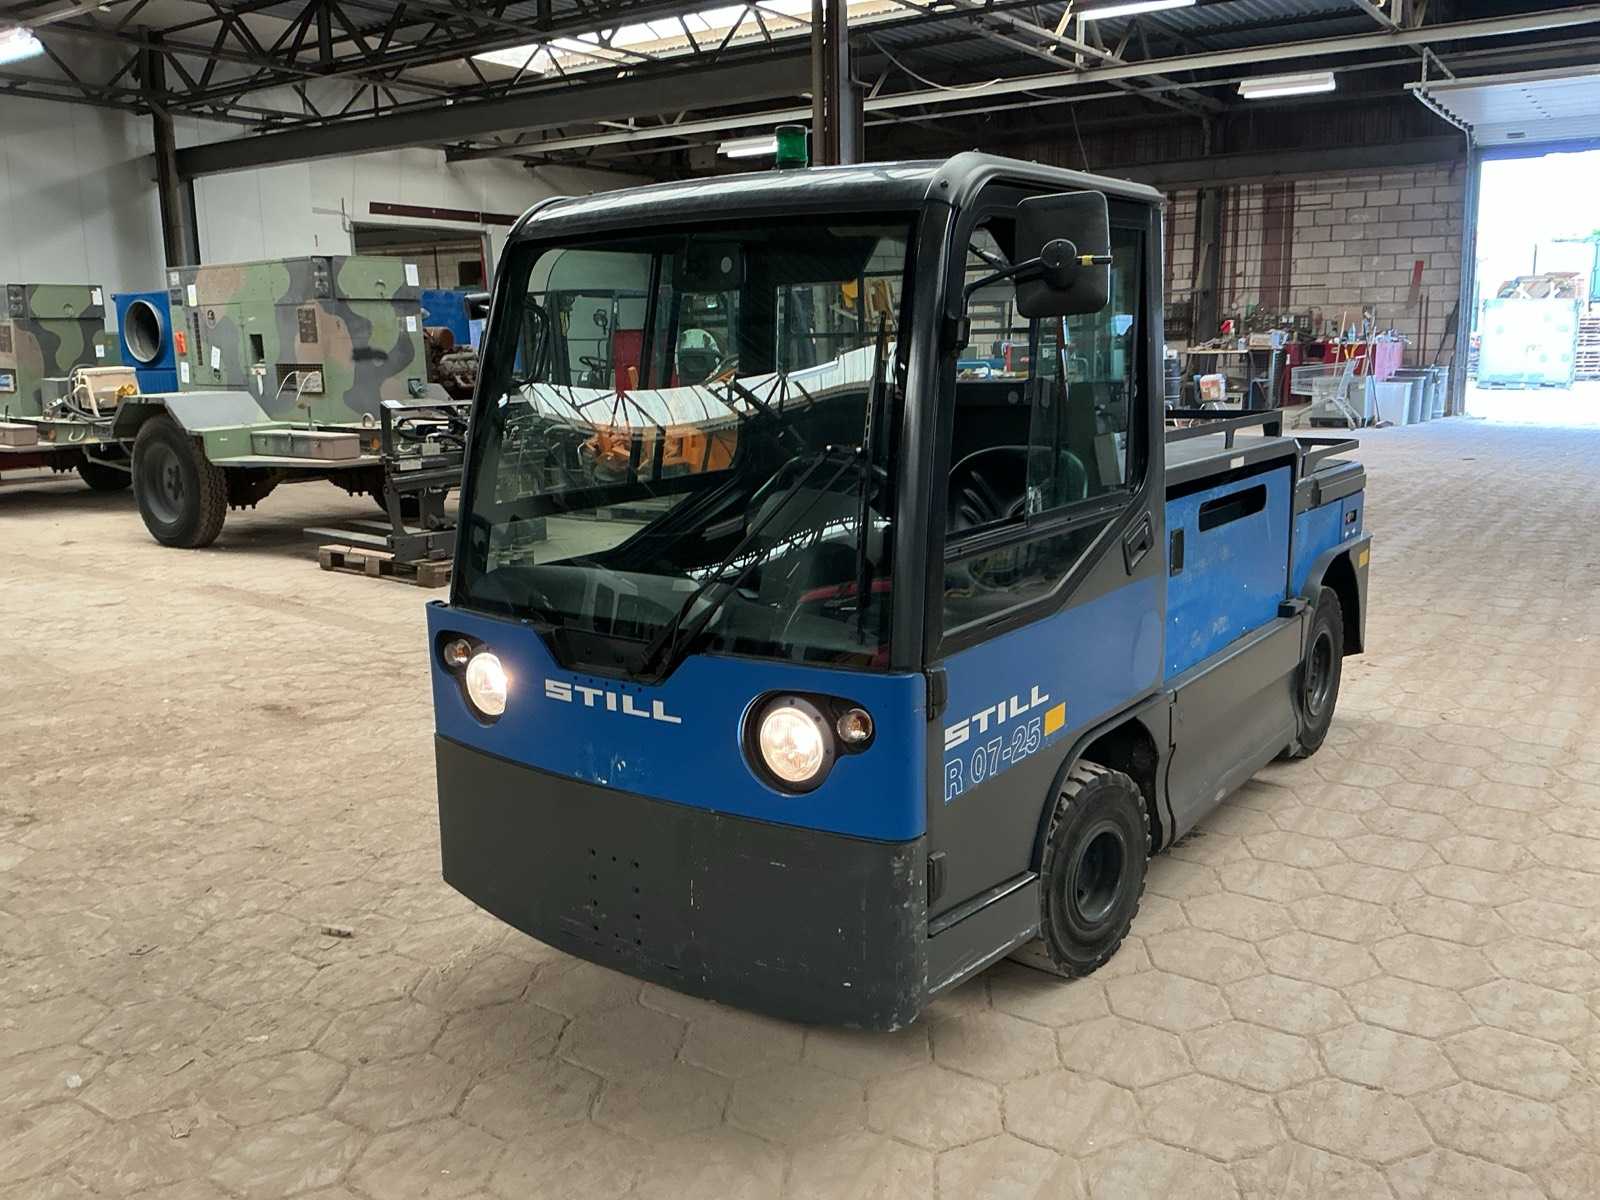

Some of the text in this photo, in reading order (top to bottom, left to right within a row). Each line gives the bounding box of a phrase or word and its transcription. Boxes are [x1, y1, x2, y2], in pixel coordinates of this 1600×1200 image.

[545, 679, 682, 724] STILL
[944, 685, 1049, 751] STILL
[944, 717, 1041, 802] R 07-25
